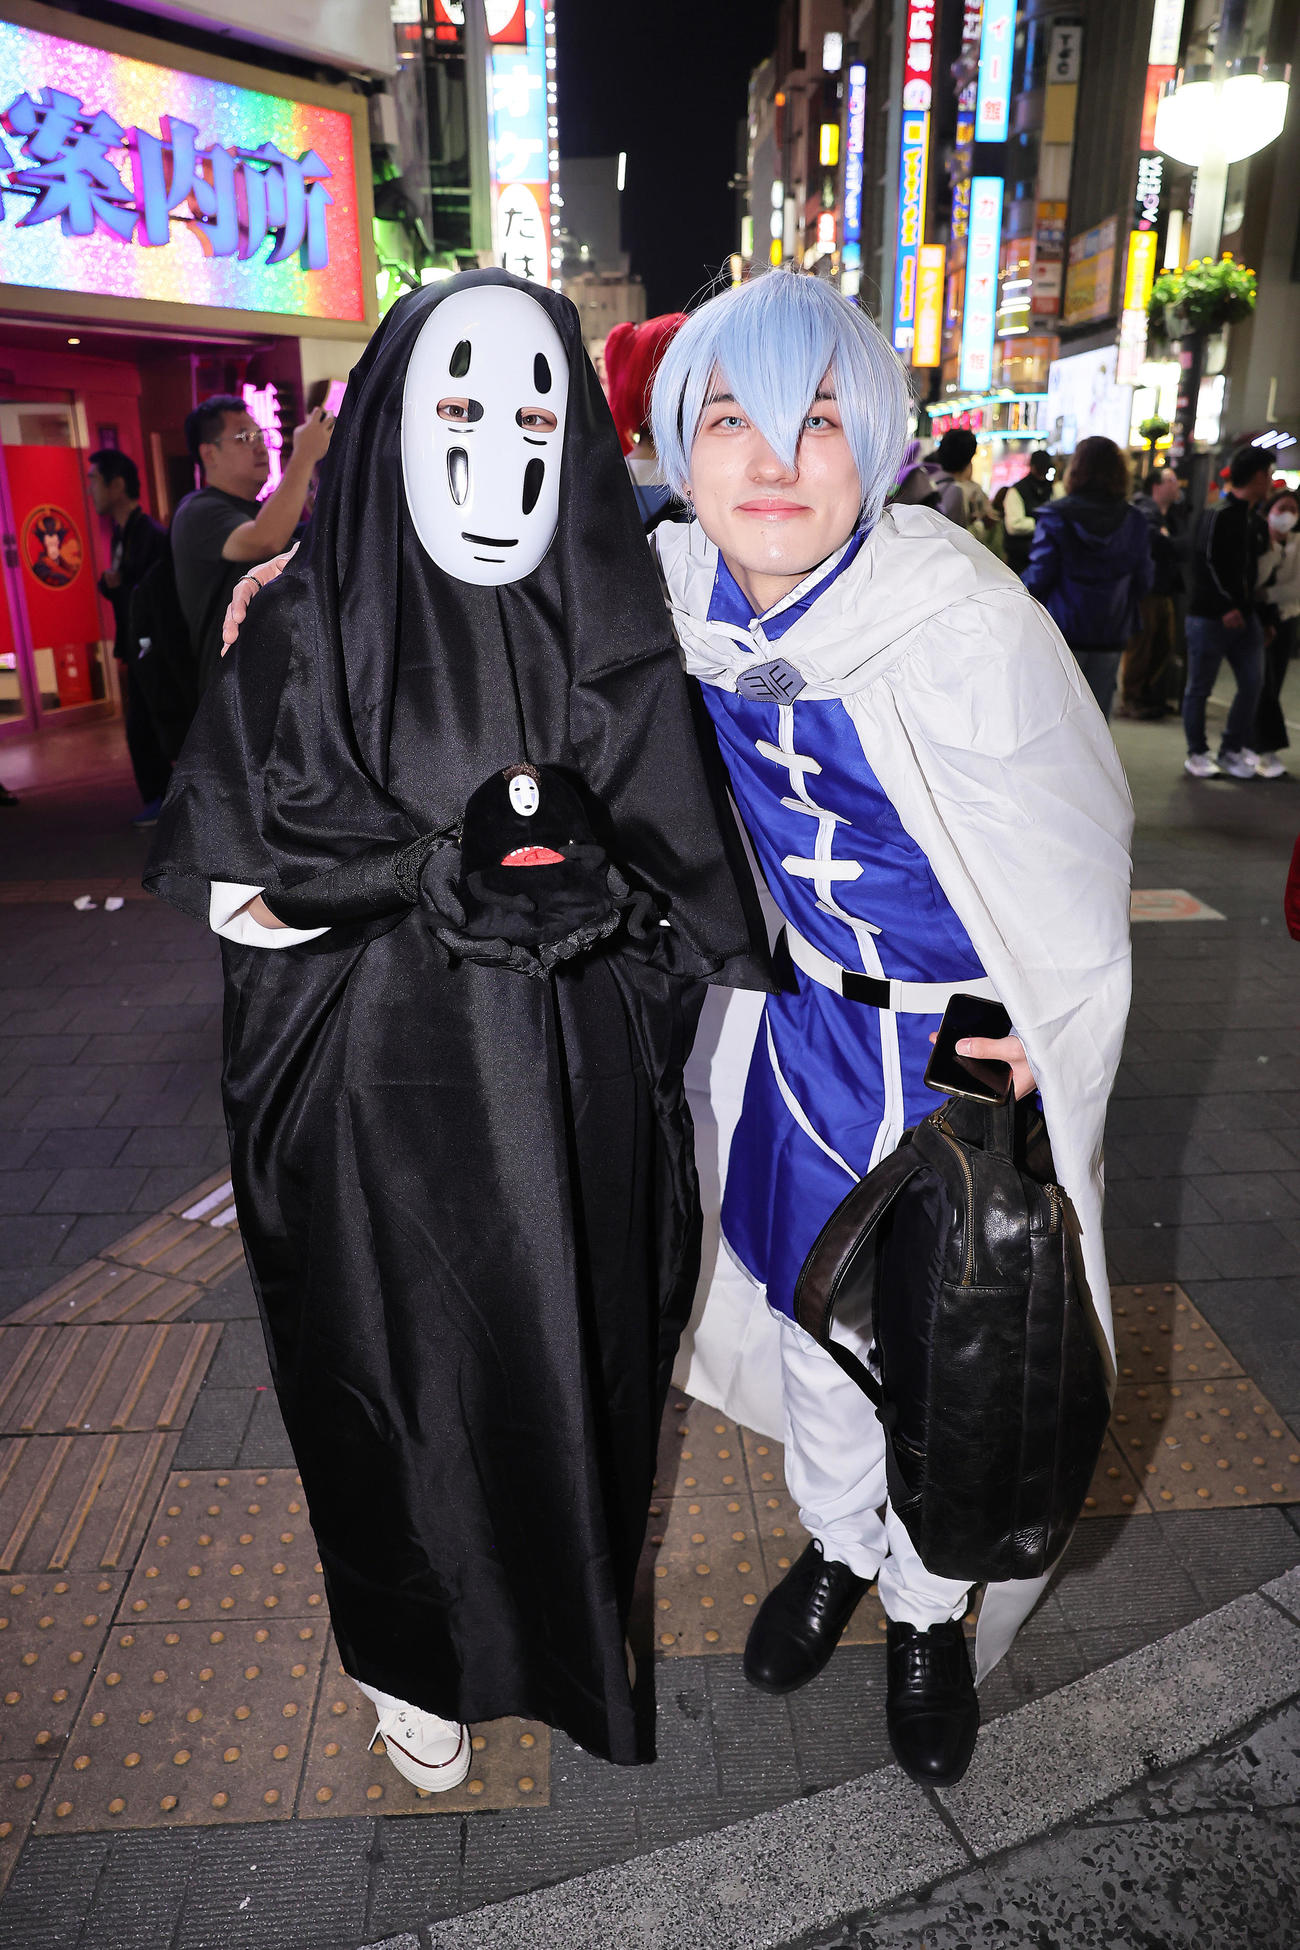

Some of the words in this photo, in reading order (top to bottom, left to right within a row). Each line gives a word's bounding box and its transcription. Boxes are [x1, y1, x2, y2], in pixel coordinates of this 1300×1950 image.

[0, 86, 334, 271] 案内所
[494, 10, 543, 182] オケ
[968, 197, 996, 371] カラオケ館
